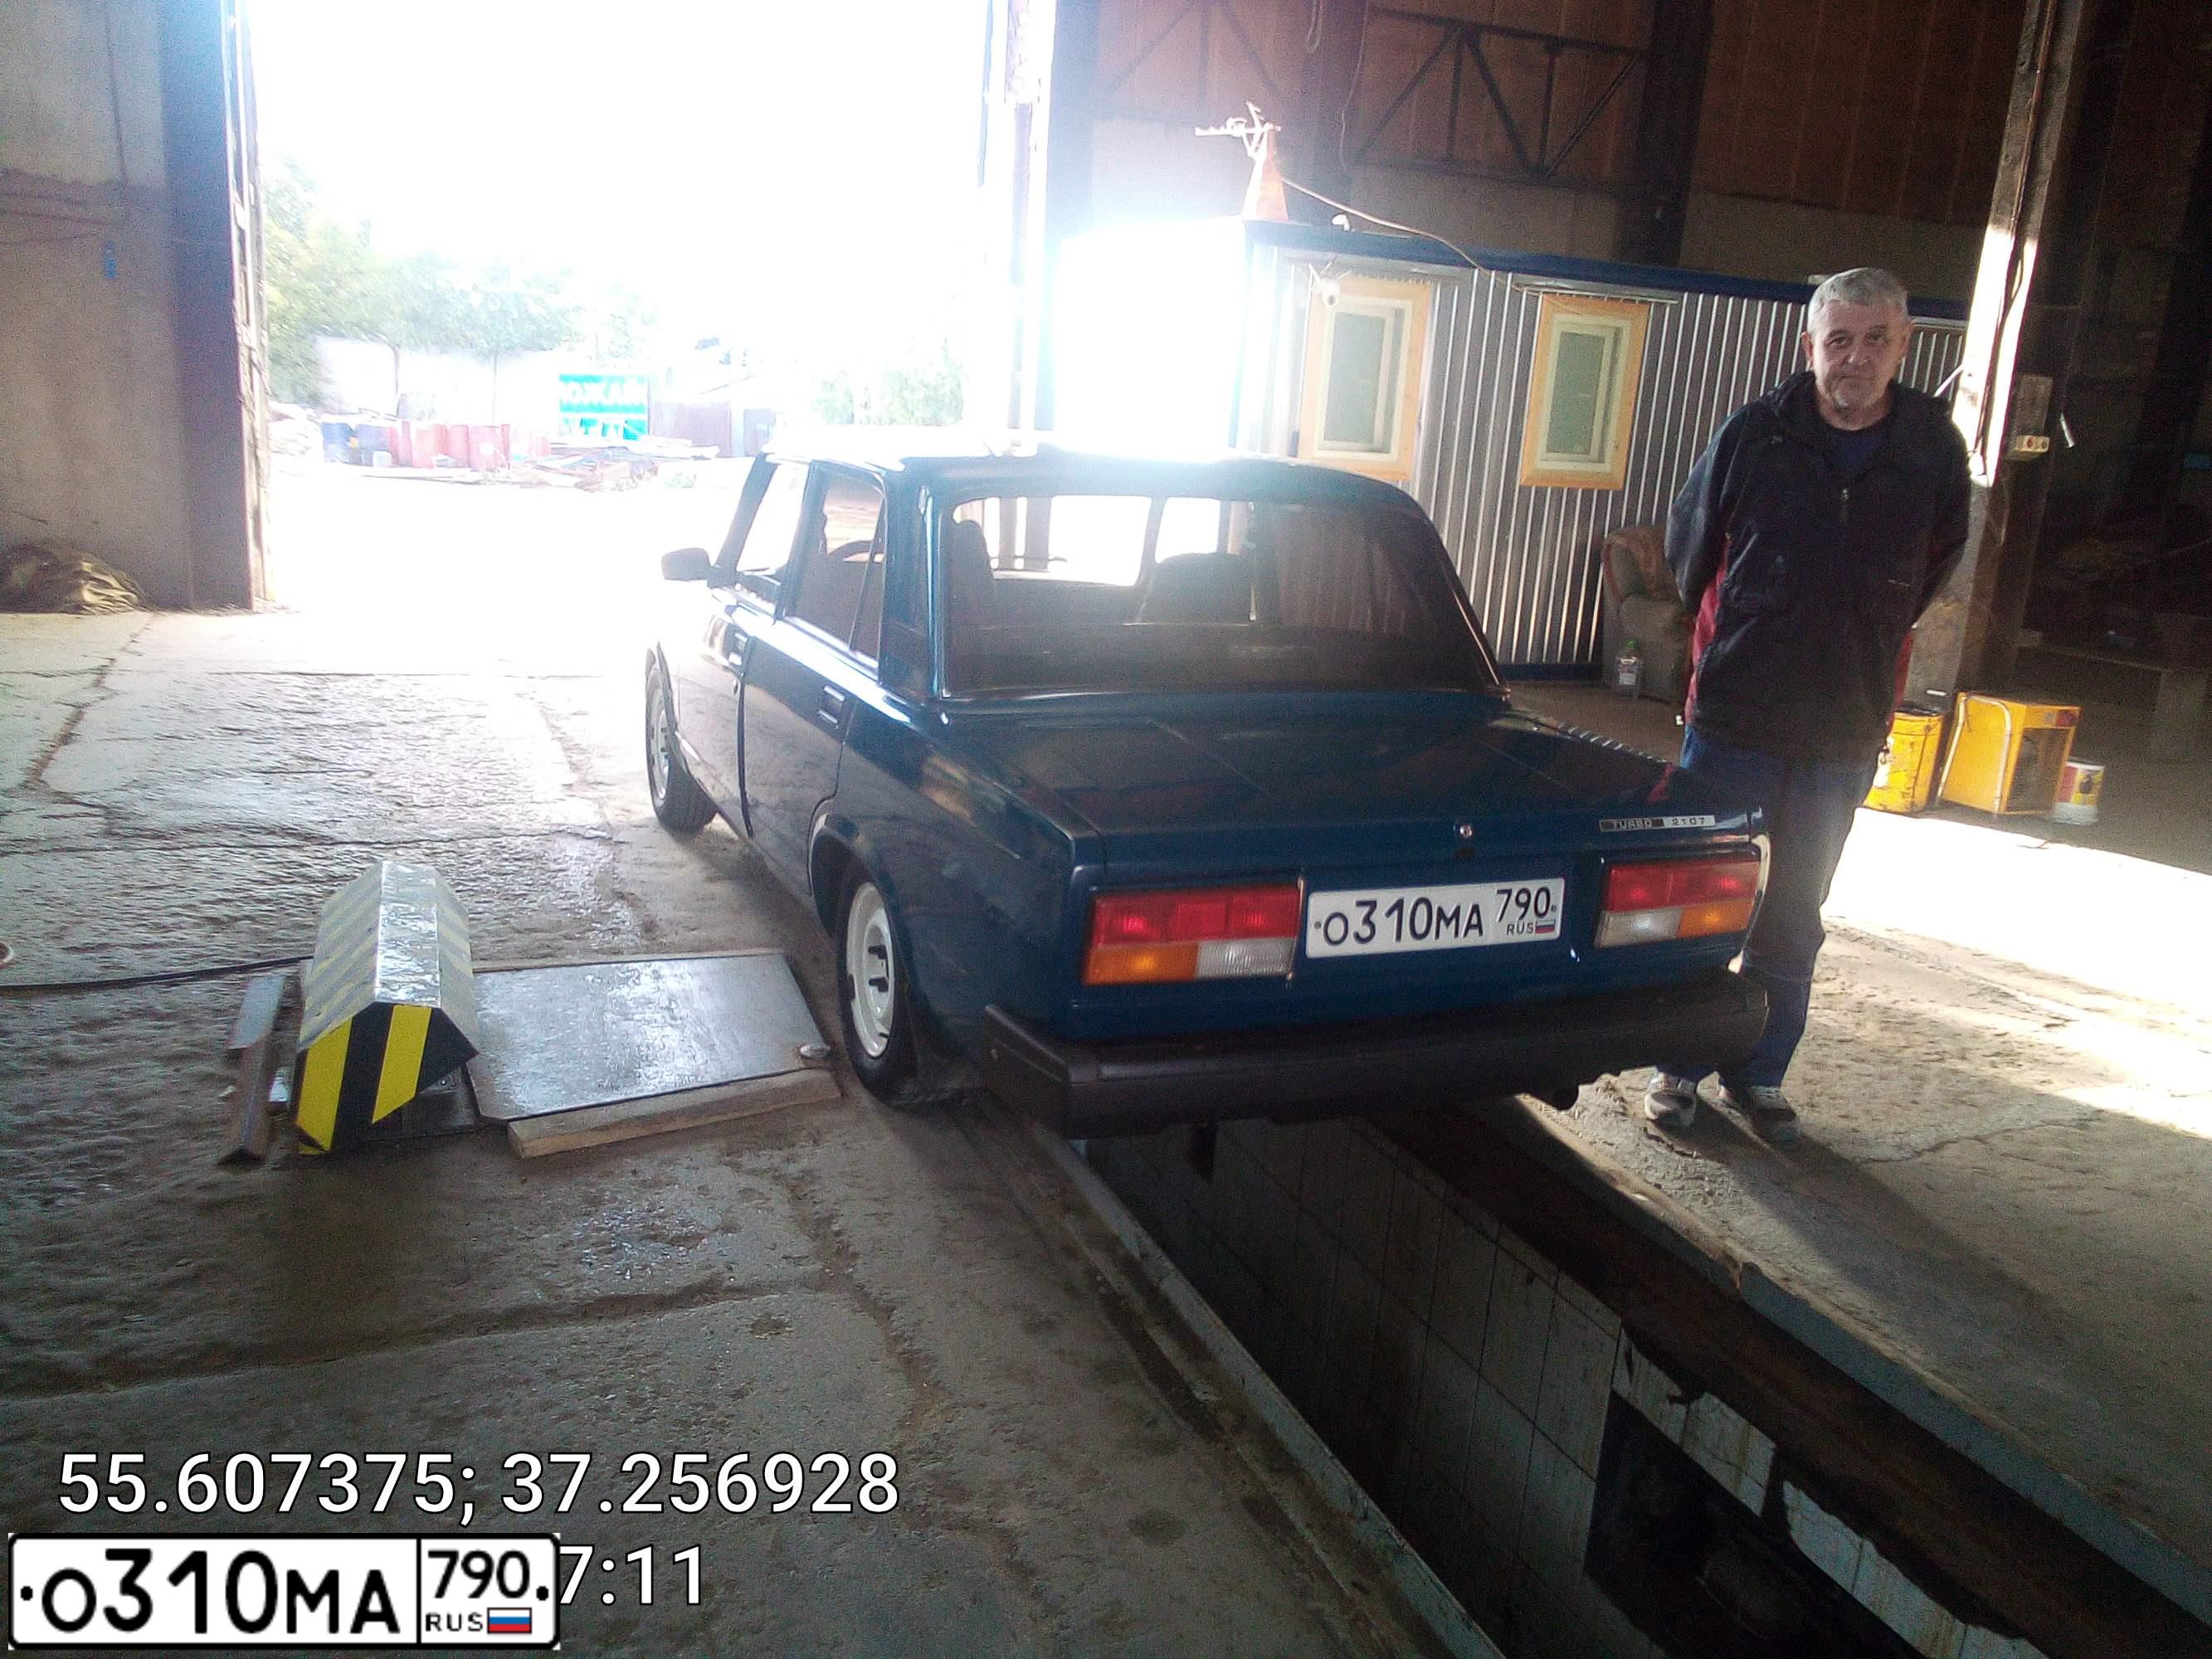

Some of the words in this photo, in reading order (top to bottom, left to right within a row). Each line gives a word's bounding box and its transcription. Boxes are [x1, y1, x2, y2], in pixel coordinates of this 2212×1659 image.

[1672, 816, 1705, 826] 2107
[1323, 897, 1484, 945] О310МА
[1496, 887, 1551, 922] 790
[1507, 921, 1534, 936] RUS
